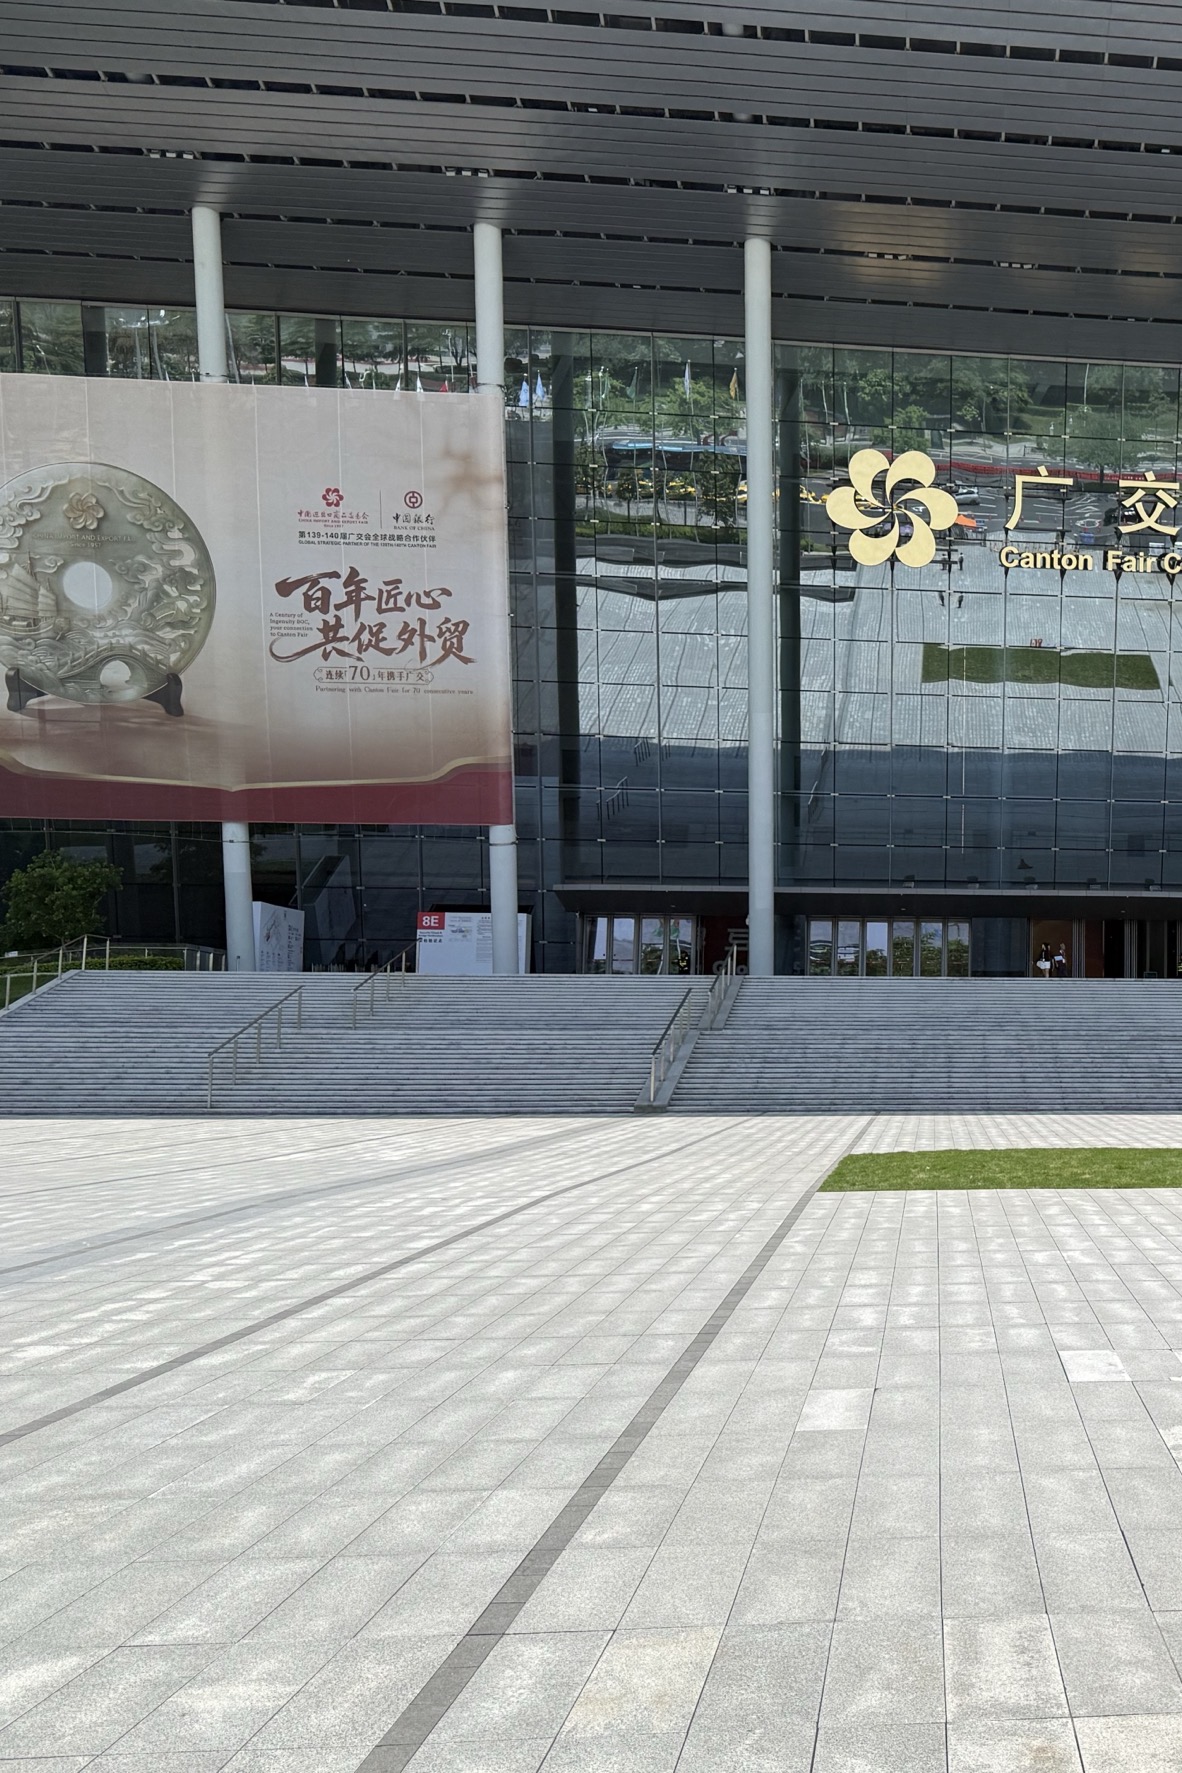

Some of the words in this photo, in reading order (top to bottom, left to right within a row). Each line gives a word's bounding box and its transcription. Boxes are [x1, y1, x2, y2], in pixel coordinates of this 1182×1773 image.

[392, 512, 435, 525] 中国银行
[1000, 546, 1093, 571] Canton
[1107, 550, 1157, 573] Fair
[275, 566, 452, 624] 百年匠心
[269, 614, 478, 672] 共促外贸
[315, 685, 346, 693] Partnering
[349, 685, 362, 693] with
[364, 686, 384, 694] Canton
[386, 686, 399, 694] Fair
[401, 686, 410, 694] for
[422, 915, 439, 926] 8E
